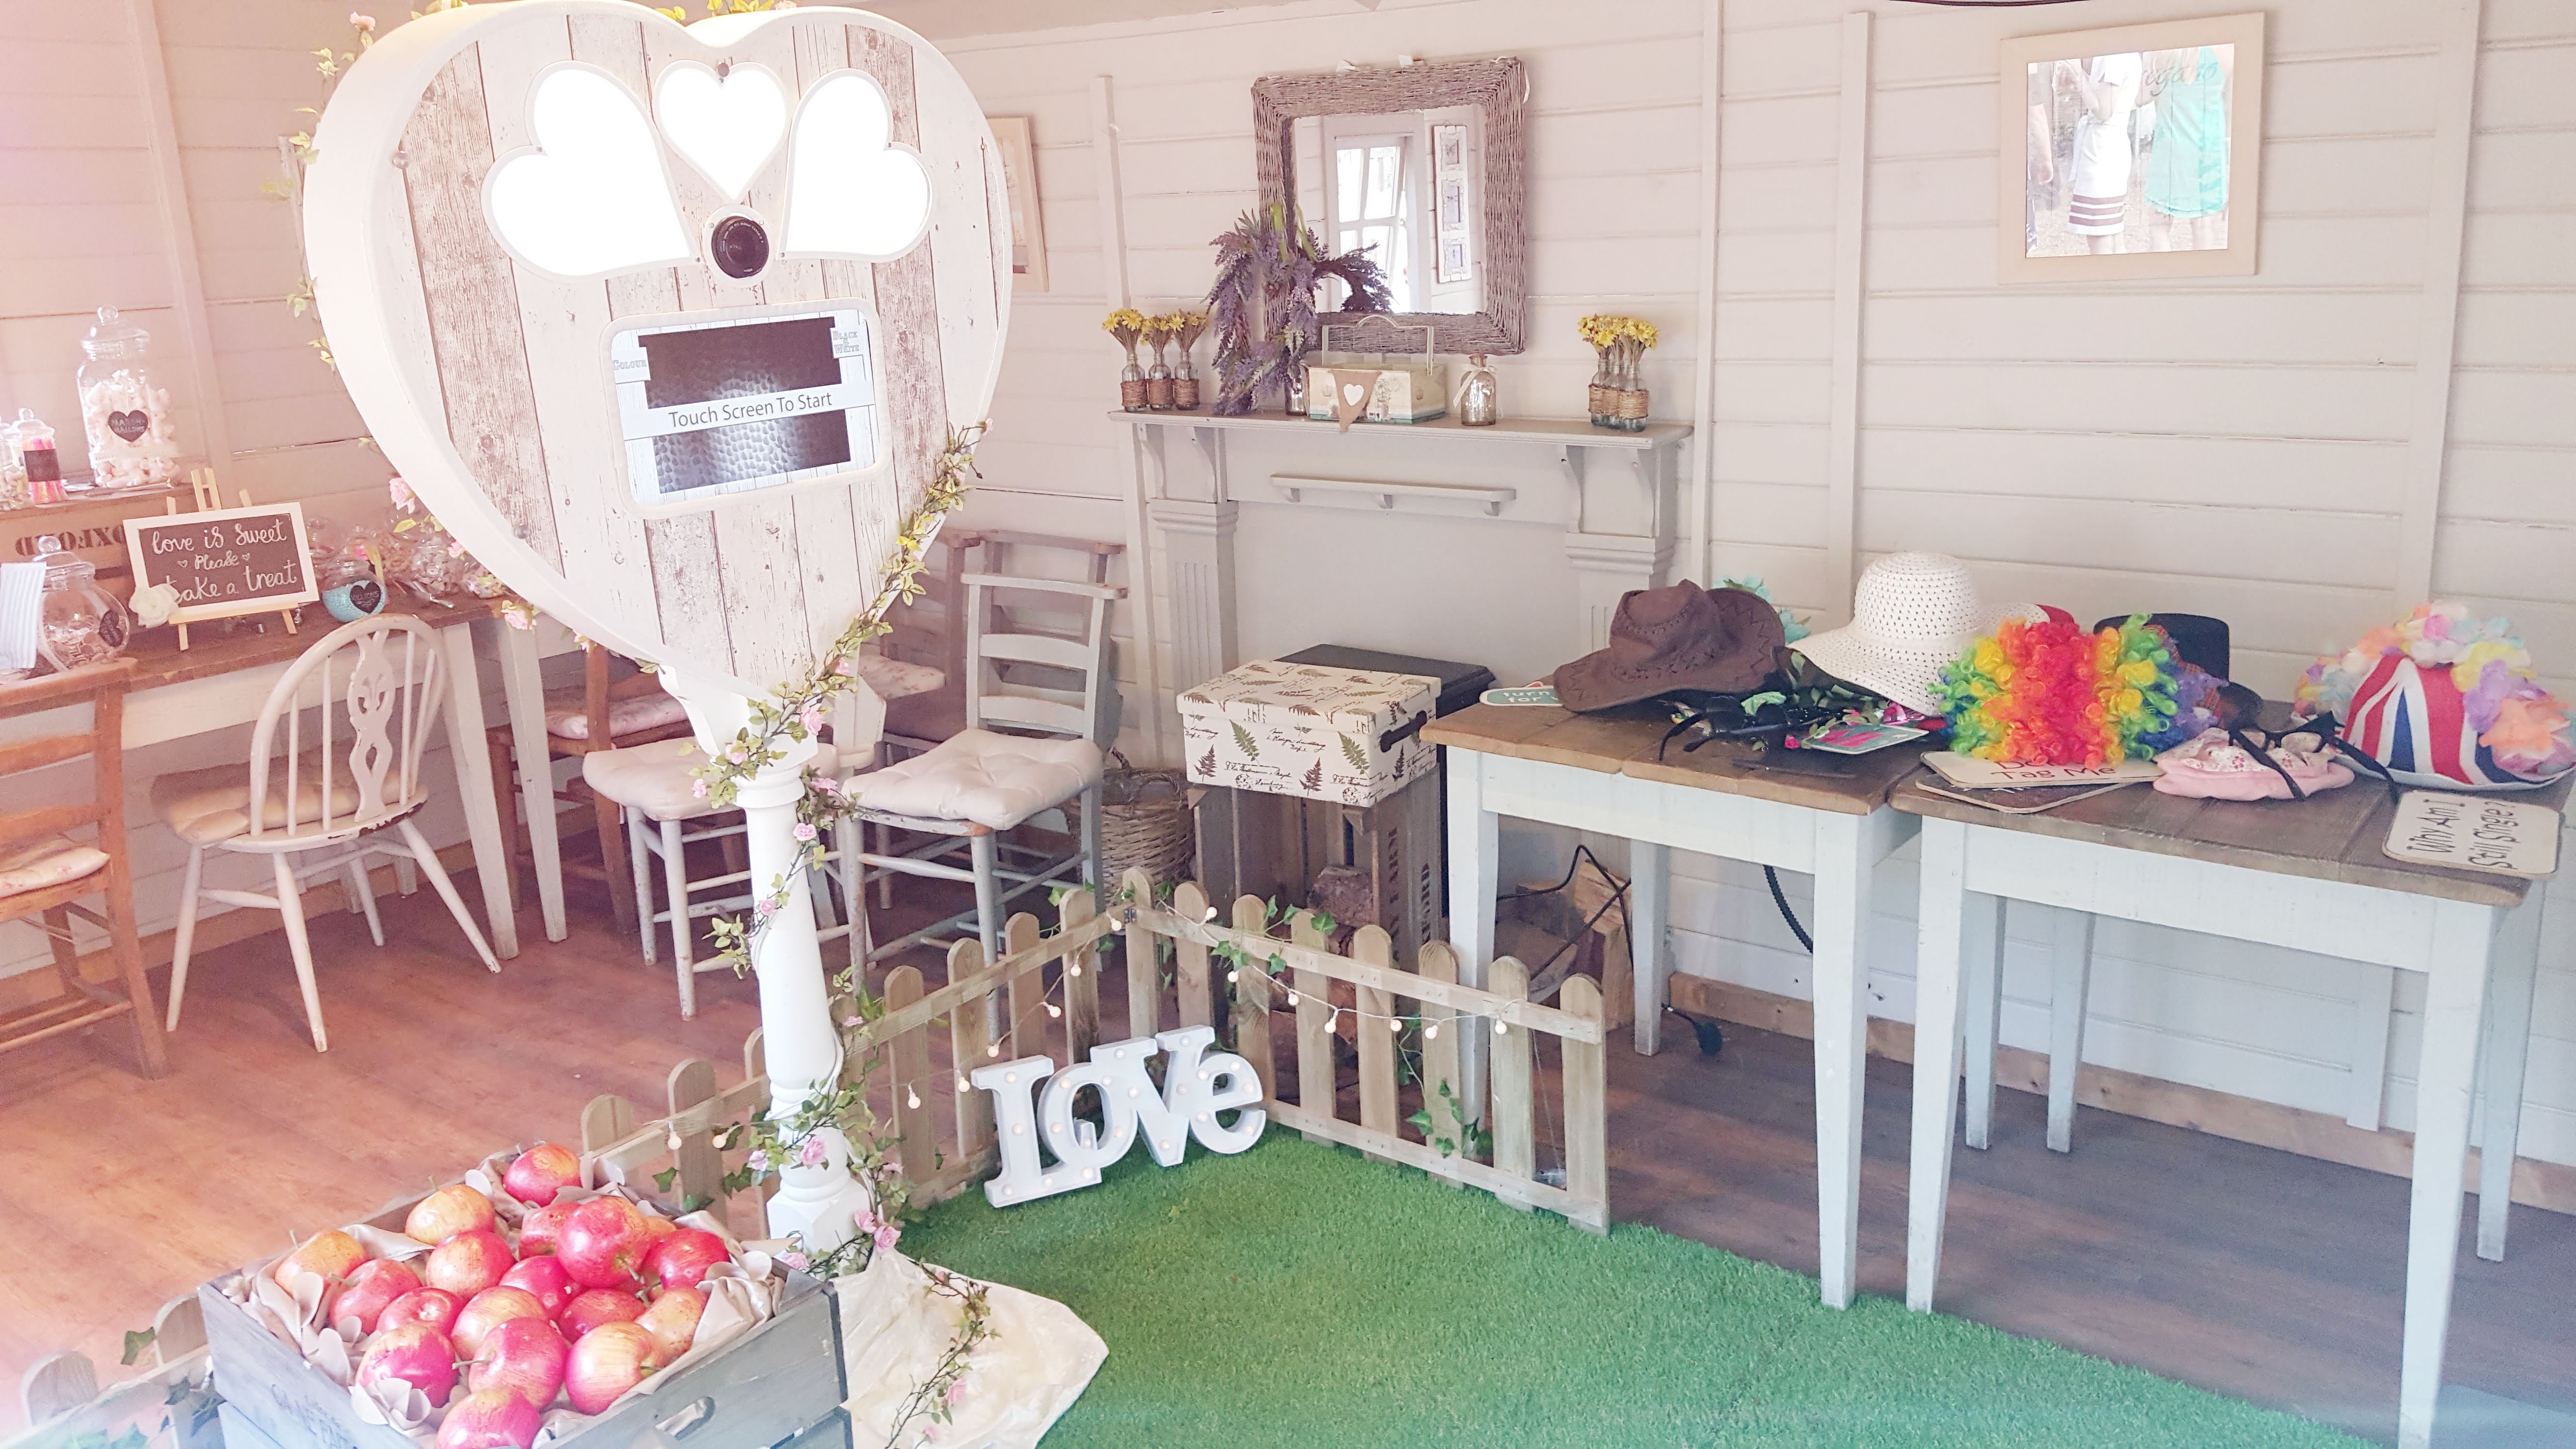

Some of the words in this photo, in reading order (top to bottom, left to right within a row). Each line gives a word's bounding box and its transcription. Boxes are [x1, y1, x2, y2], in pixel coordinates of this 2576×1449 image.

[669, 406, 718, 427] Touch
[722, 402, 774, 420] Screen
[776, 397, 794, 413] To
[798, 392, 832, 410] Start
[15, 525, 126, 556] OXFOD
[194, 550, 240, 570] Please
[226, 582, 239, 595] a
[243, 559, 297, 591] treat
[1991, 770, 2056, 780] Tag
[2064, 767, 2116, 777] Me
[2423, 798, 2466, 807] I
[2416, 806, 2461, 828] Am
[2406, 826, 2456, 853] Why
[2467, 842, 2518, 870] Still
